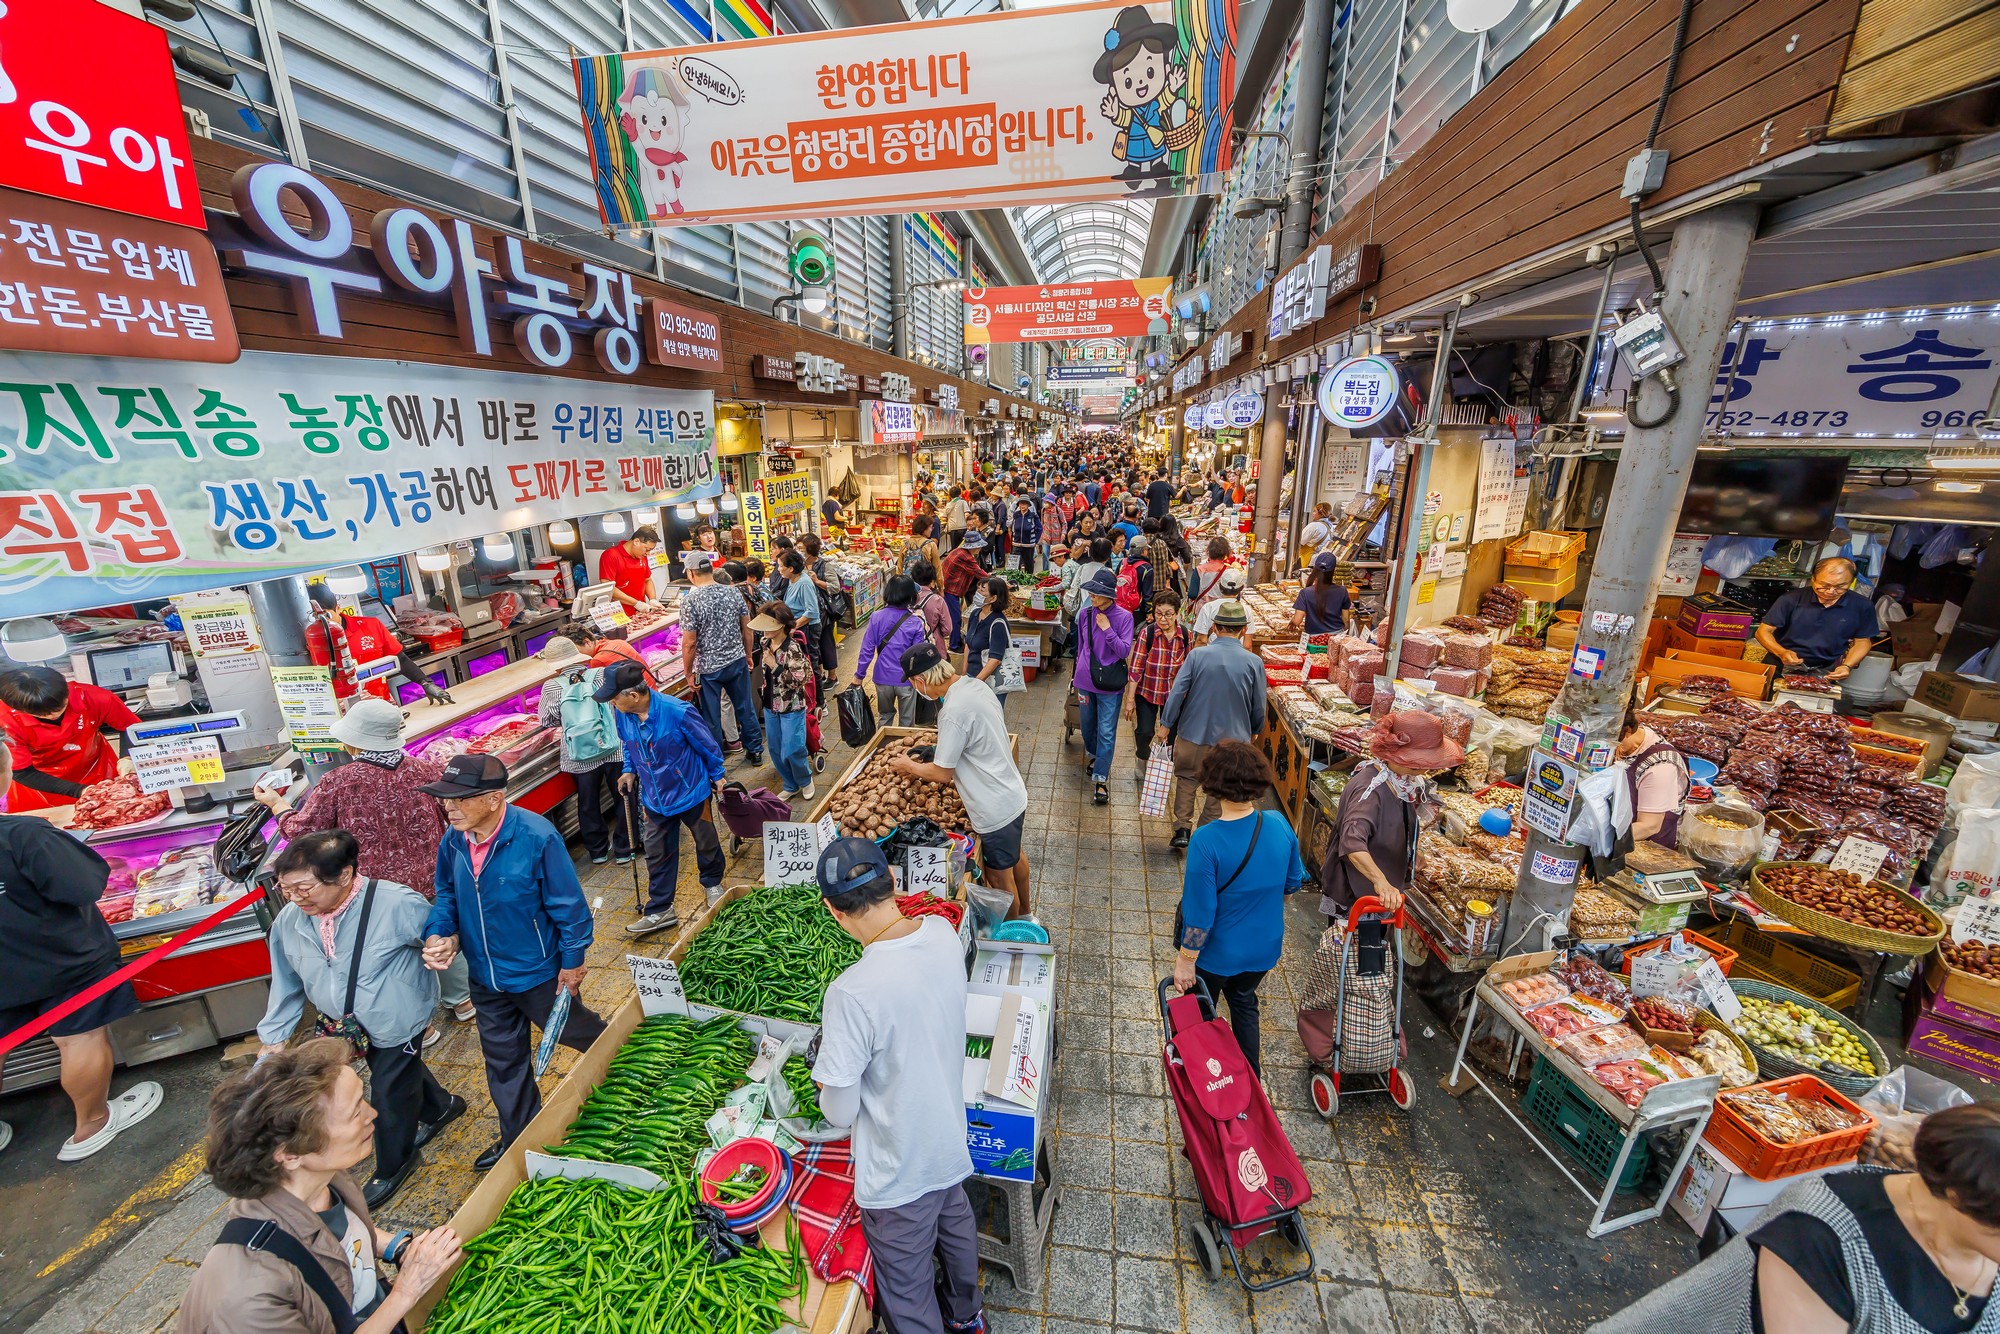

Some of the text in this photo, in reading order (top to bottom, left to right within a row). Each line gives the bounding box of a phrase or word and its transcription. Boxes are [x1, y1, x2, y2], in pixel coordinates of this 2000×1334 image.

[684, 66, 731, 98] 안녕하세요!
[815, 51, 970, 110] 환영합니다
[25, 101, 184, 210] 우아
[228, 162, 643, 376] 우아농장
[994, 296, 1140, 314] 서울시 디자인 혁신 전통시장 조성
[1147, 297, 1163, 314] 축
[971, 306, 988, 324] 경
[1036, 311, 1097, 323] 공모사업 선정
[278, 391, 464, 455] 농장에서
[477, 400, 539, 446] 바로
[551, 402, 623, 444] 우리집
[634, 407, 706, 444] 식탁으로
[766, 477, 809, 506] 홍어회무침
[0, 488, 182, 573] 직접
[507, 458, 608, 503] 도매가로
[618, 451, 713, 494] 판매합니다
[745, 495, 766, 553] 홍어무침
[193, 618, 245, 634] 환급행사
[197, 630, 249, 645] 참여점포
[778, 860, 814, 878] 3000
[1927, 1042, 1962, 1057] Shelled
[1206, 1075, 1234, 1092] shopping
